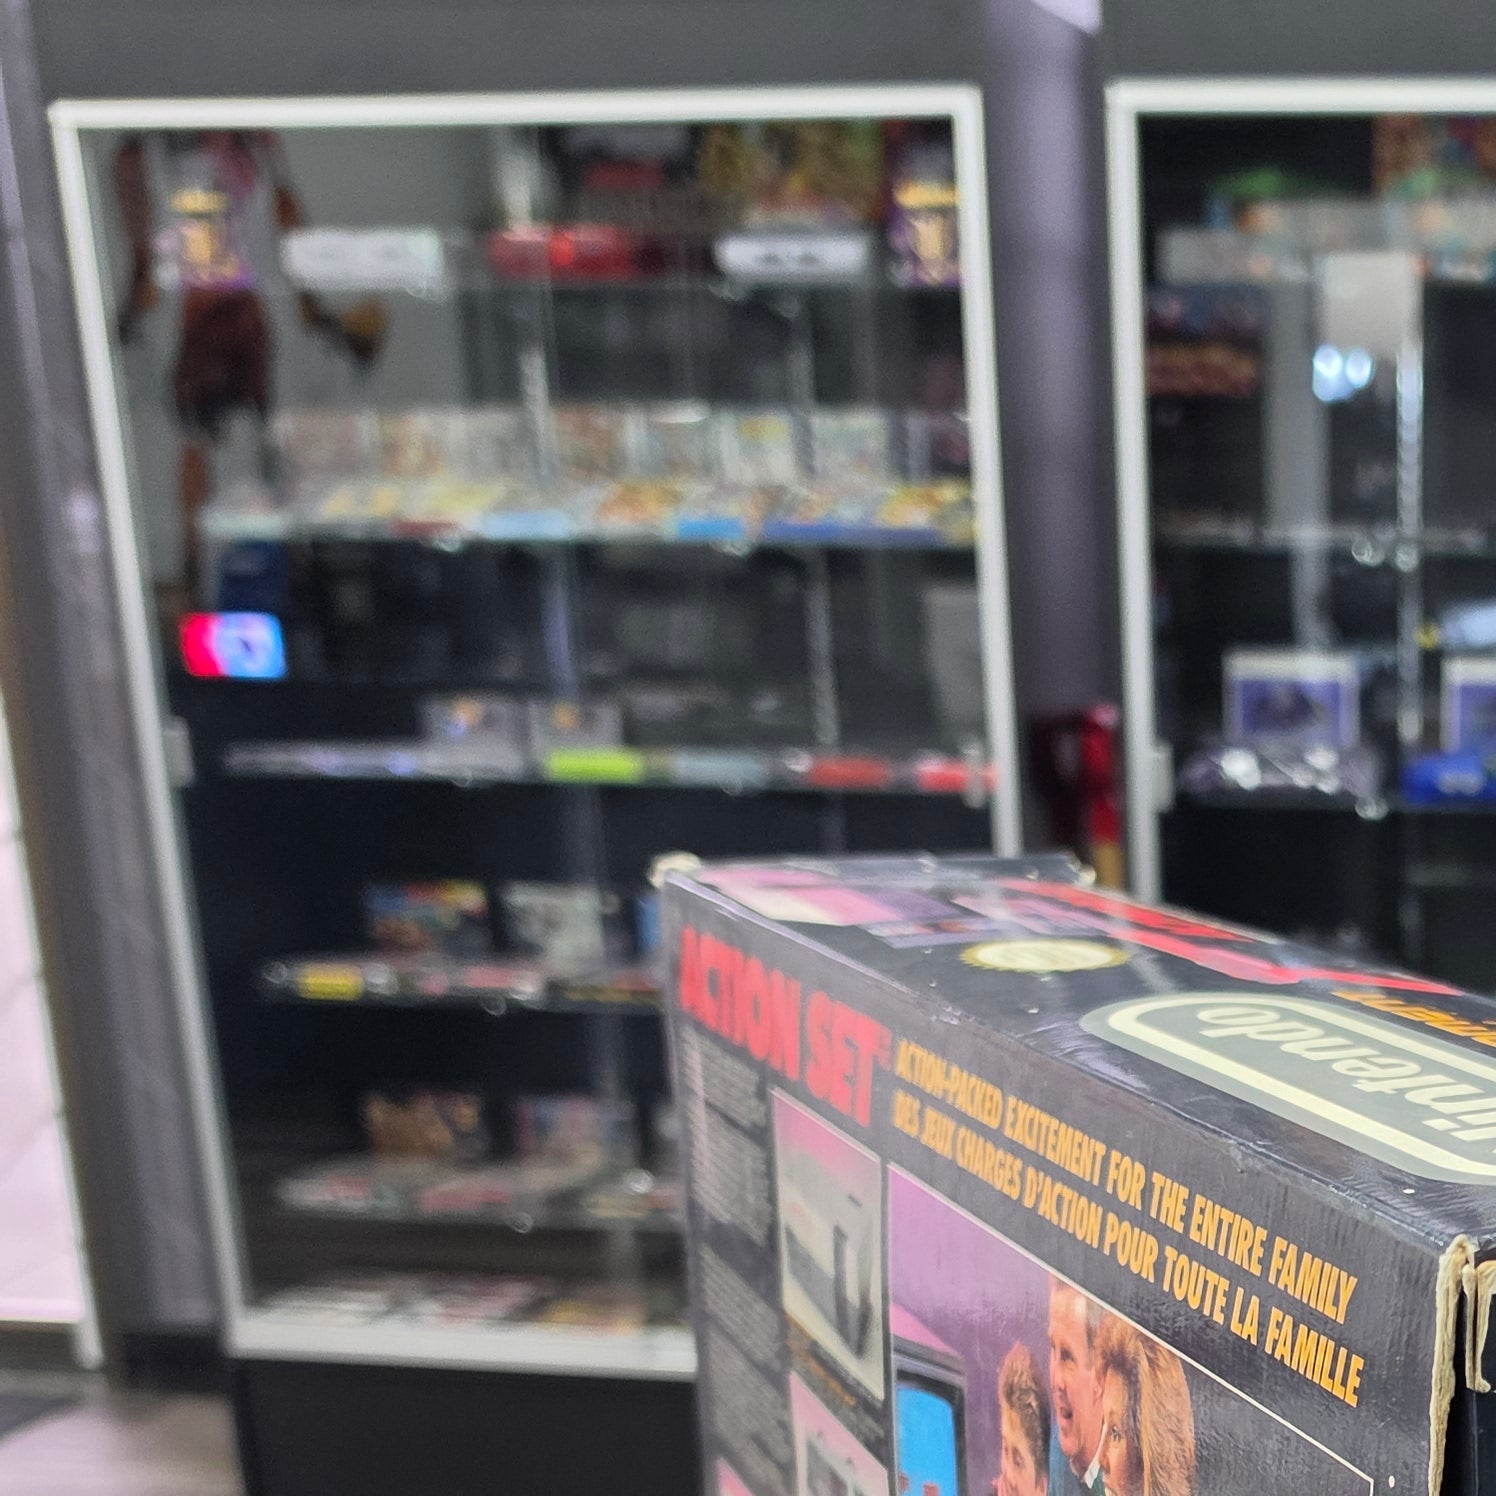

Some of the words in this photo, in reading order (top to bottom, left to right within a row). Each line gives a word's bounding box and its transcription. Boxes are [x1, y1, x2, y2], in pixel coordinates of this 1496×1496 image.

[680, 927, 799, 1081] ACTION
[808, 990, 877, 1127] SET
[1003, 1097, 1106, 1184] EXCITEMENT
[1106, 1150, 1146, 1209] FOR
[1150, 1172, 1189, 1233] THE
[1189, 1195, 1267, 1275] ENTIRE
[1269, 1237, 1357, 1323] FAMILY
[1023, 1167, 1102, 1246] D'ACTION
[1103, 1213, 1159, 1280] POUR
[1163, 1247, 1229, 1323] TOUTE
[1230, 1288, 1259, 1345] LA
[1265, 1308, 1364, 1406] FAMILLE
